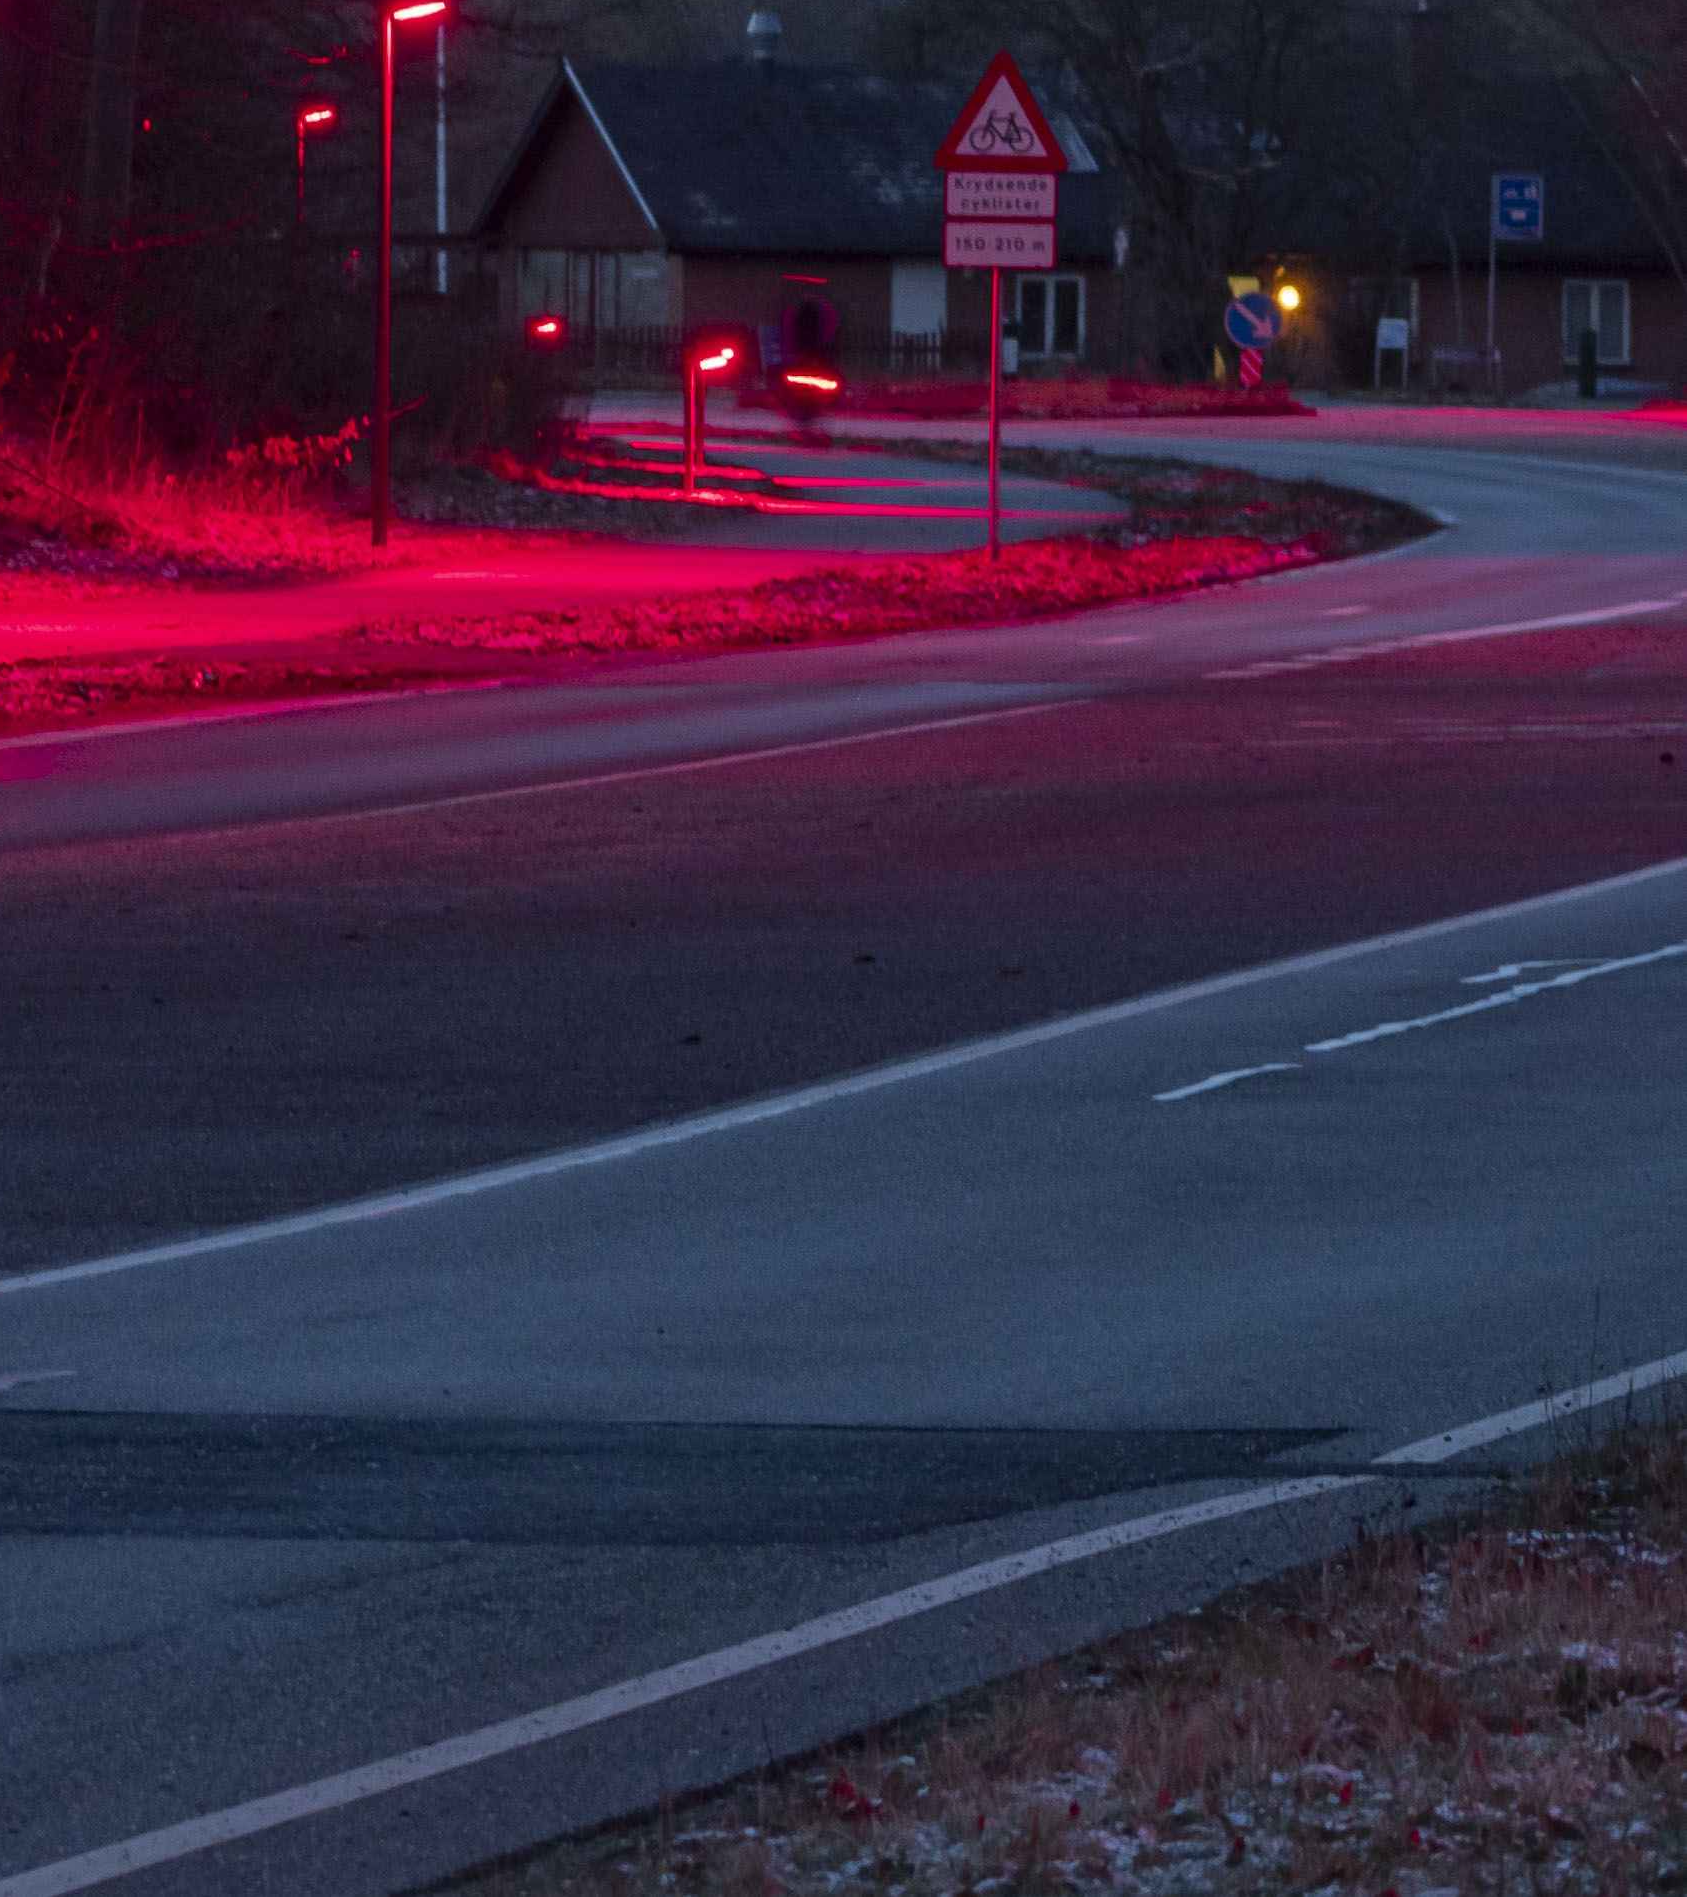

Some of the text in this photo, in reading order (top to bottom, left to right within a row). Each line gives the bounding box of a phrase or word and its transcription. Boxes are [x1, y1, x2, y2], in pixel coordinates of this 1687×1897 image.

[954, 178, 1047, 193] Krydsende
[961, 198, 1039, 211] cyklister
[1032, 241, 1045, 251] m
